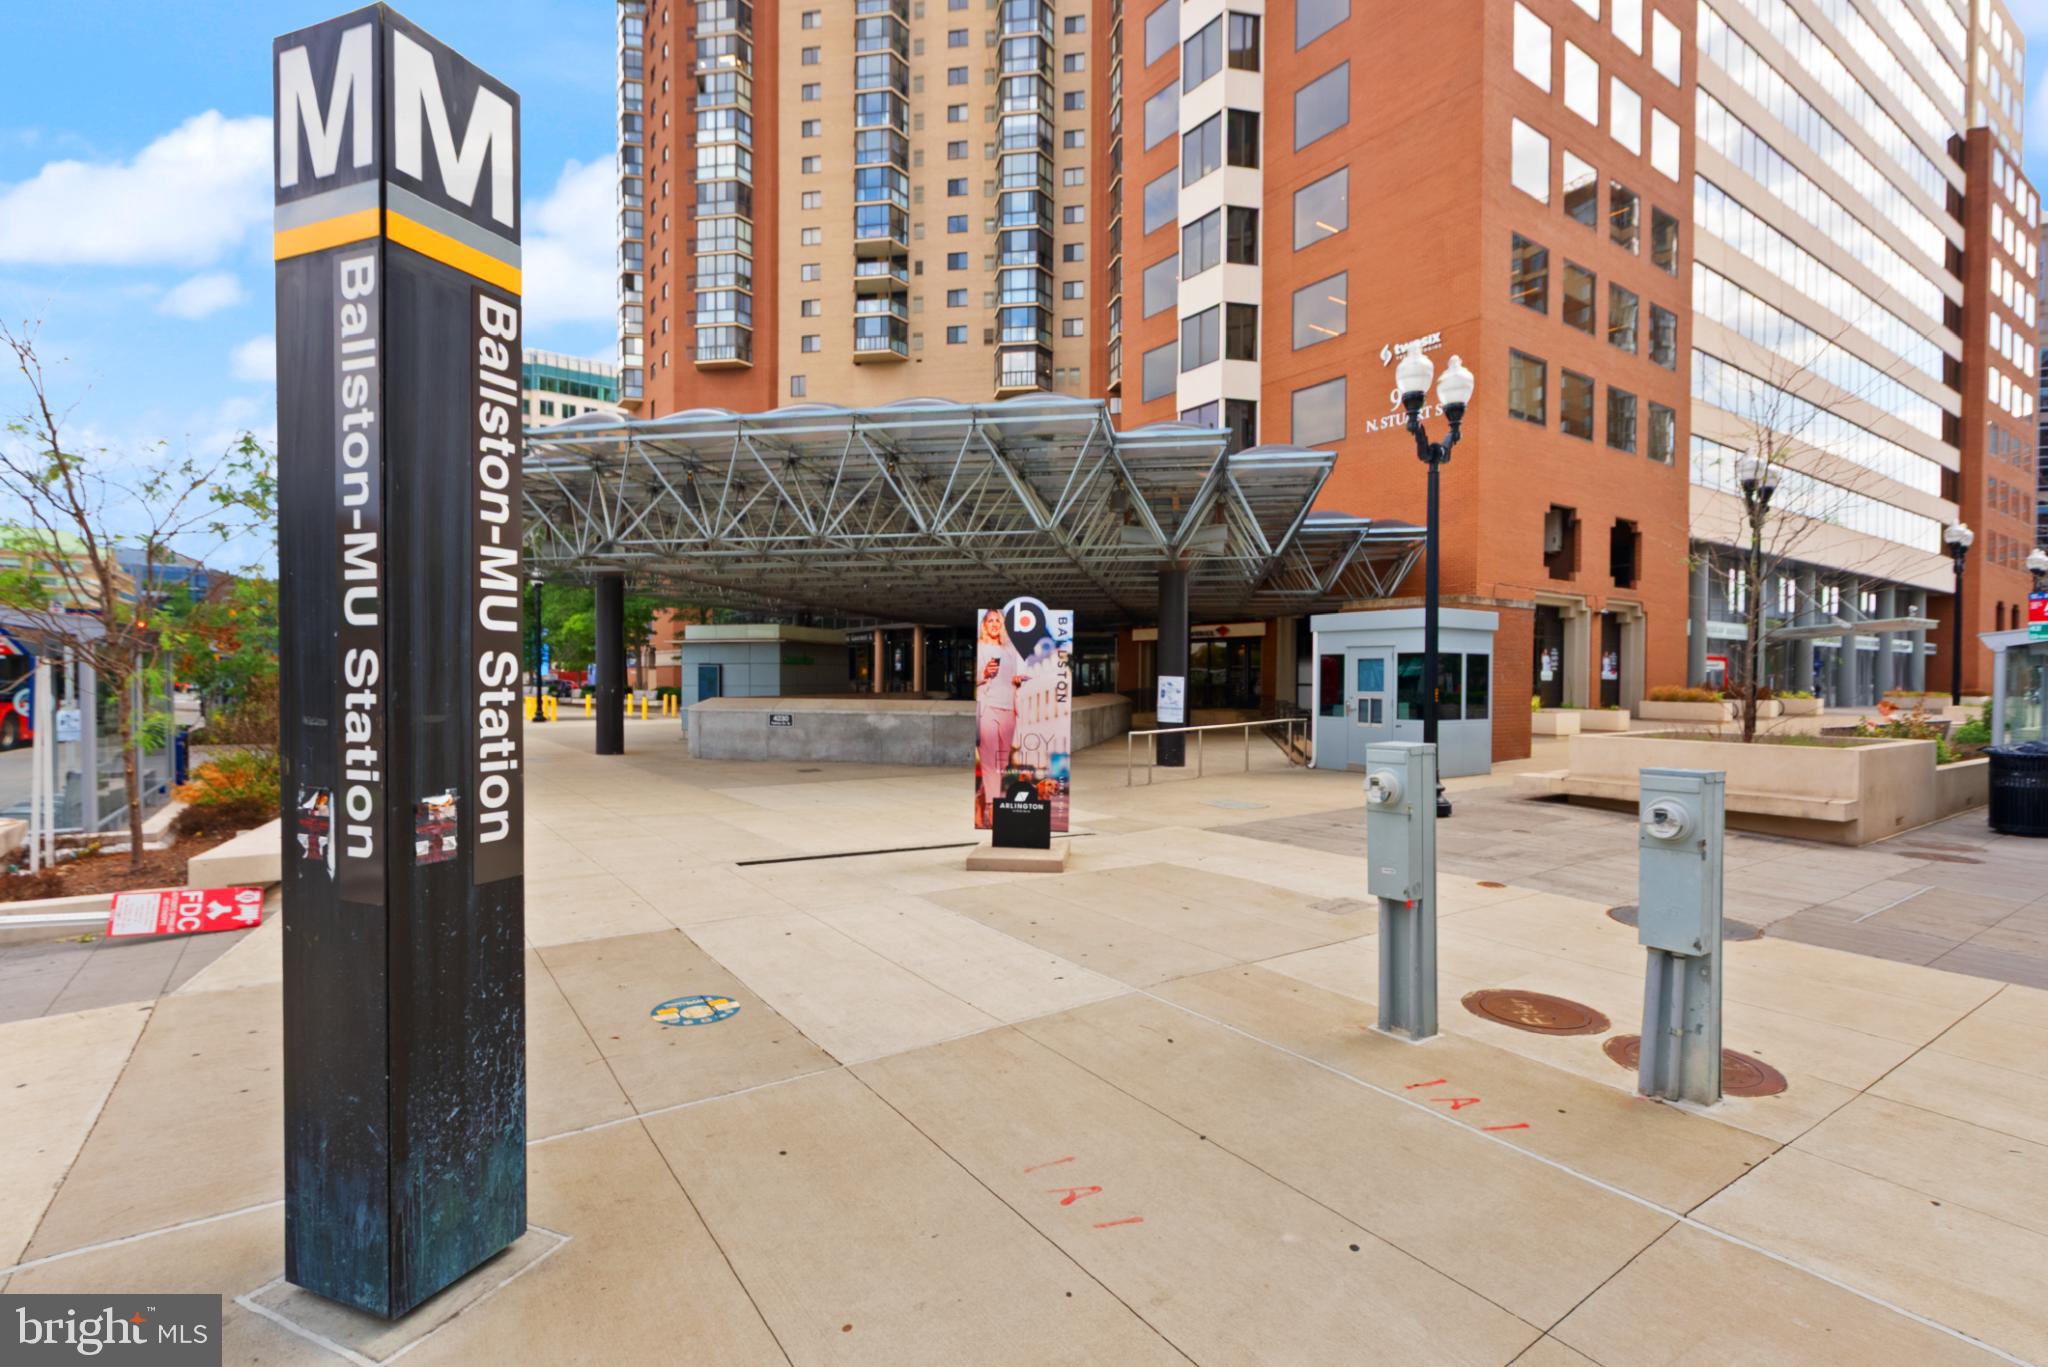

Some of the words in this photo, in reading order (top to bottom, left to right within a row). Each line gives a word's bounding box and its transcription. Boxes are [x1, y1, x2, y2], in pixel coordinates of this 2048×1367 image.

[279, 22, 373, 189] M
[394, 29, 514, 229] M
[340, 254, 378, 626] Ballston-MU
[479, 294, 518, 632] Ballston-MU
[344, 648, 380, 859] Station
[479, 650, 519, 844] Station
[999, 802, 1044, 810] ARLINGTON
[177, 890, 204, 931] FDC
